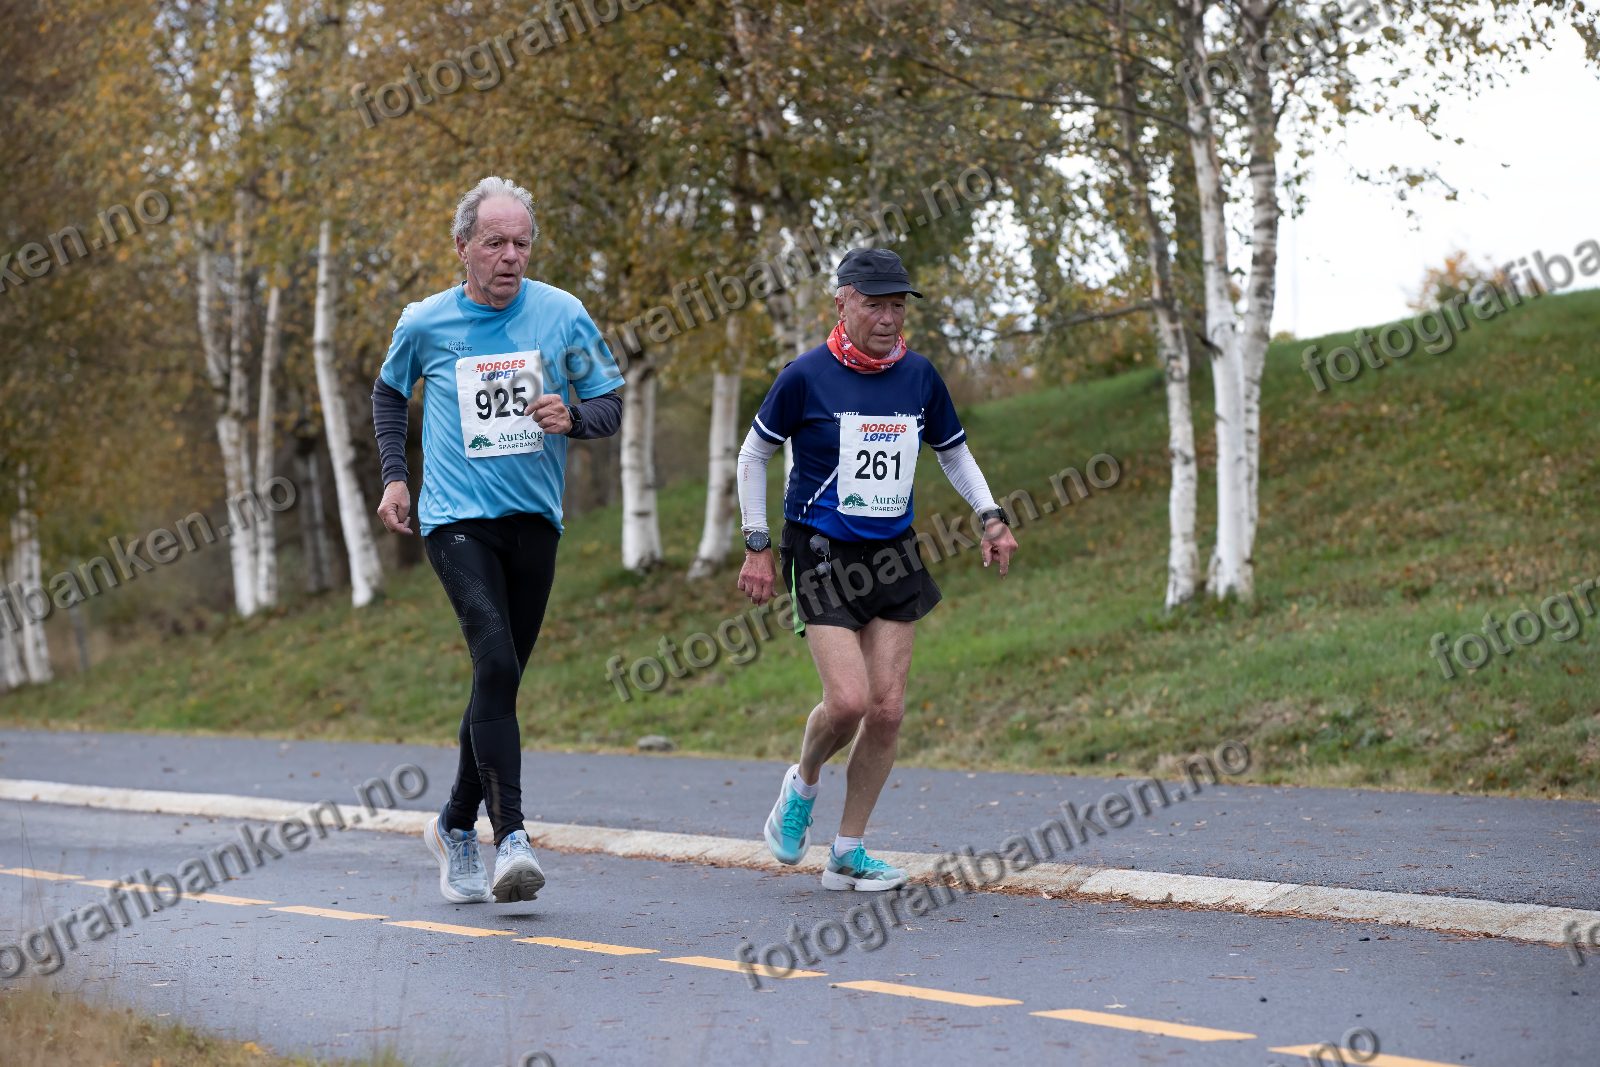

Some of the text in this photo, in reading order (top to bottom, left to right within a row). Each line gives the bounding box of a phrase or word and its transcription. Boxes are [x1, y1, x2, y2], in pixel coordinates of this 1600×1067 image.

[475, 359, 526, 373] NORGES
[480, 369, 519, 382] LØPET
[475, 386, 529, 420] 925
[860, 423, 908, 434] NORGES
[498, 429, 543, 443] Aurskog
[863, 432, 901, 442] LØPET
[498, 441, 537, 450] SPAREBANK
[855, 449, 901, 480] 261
